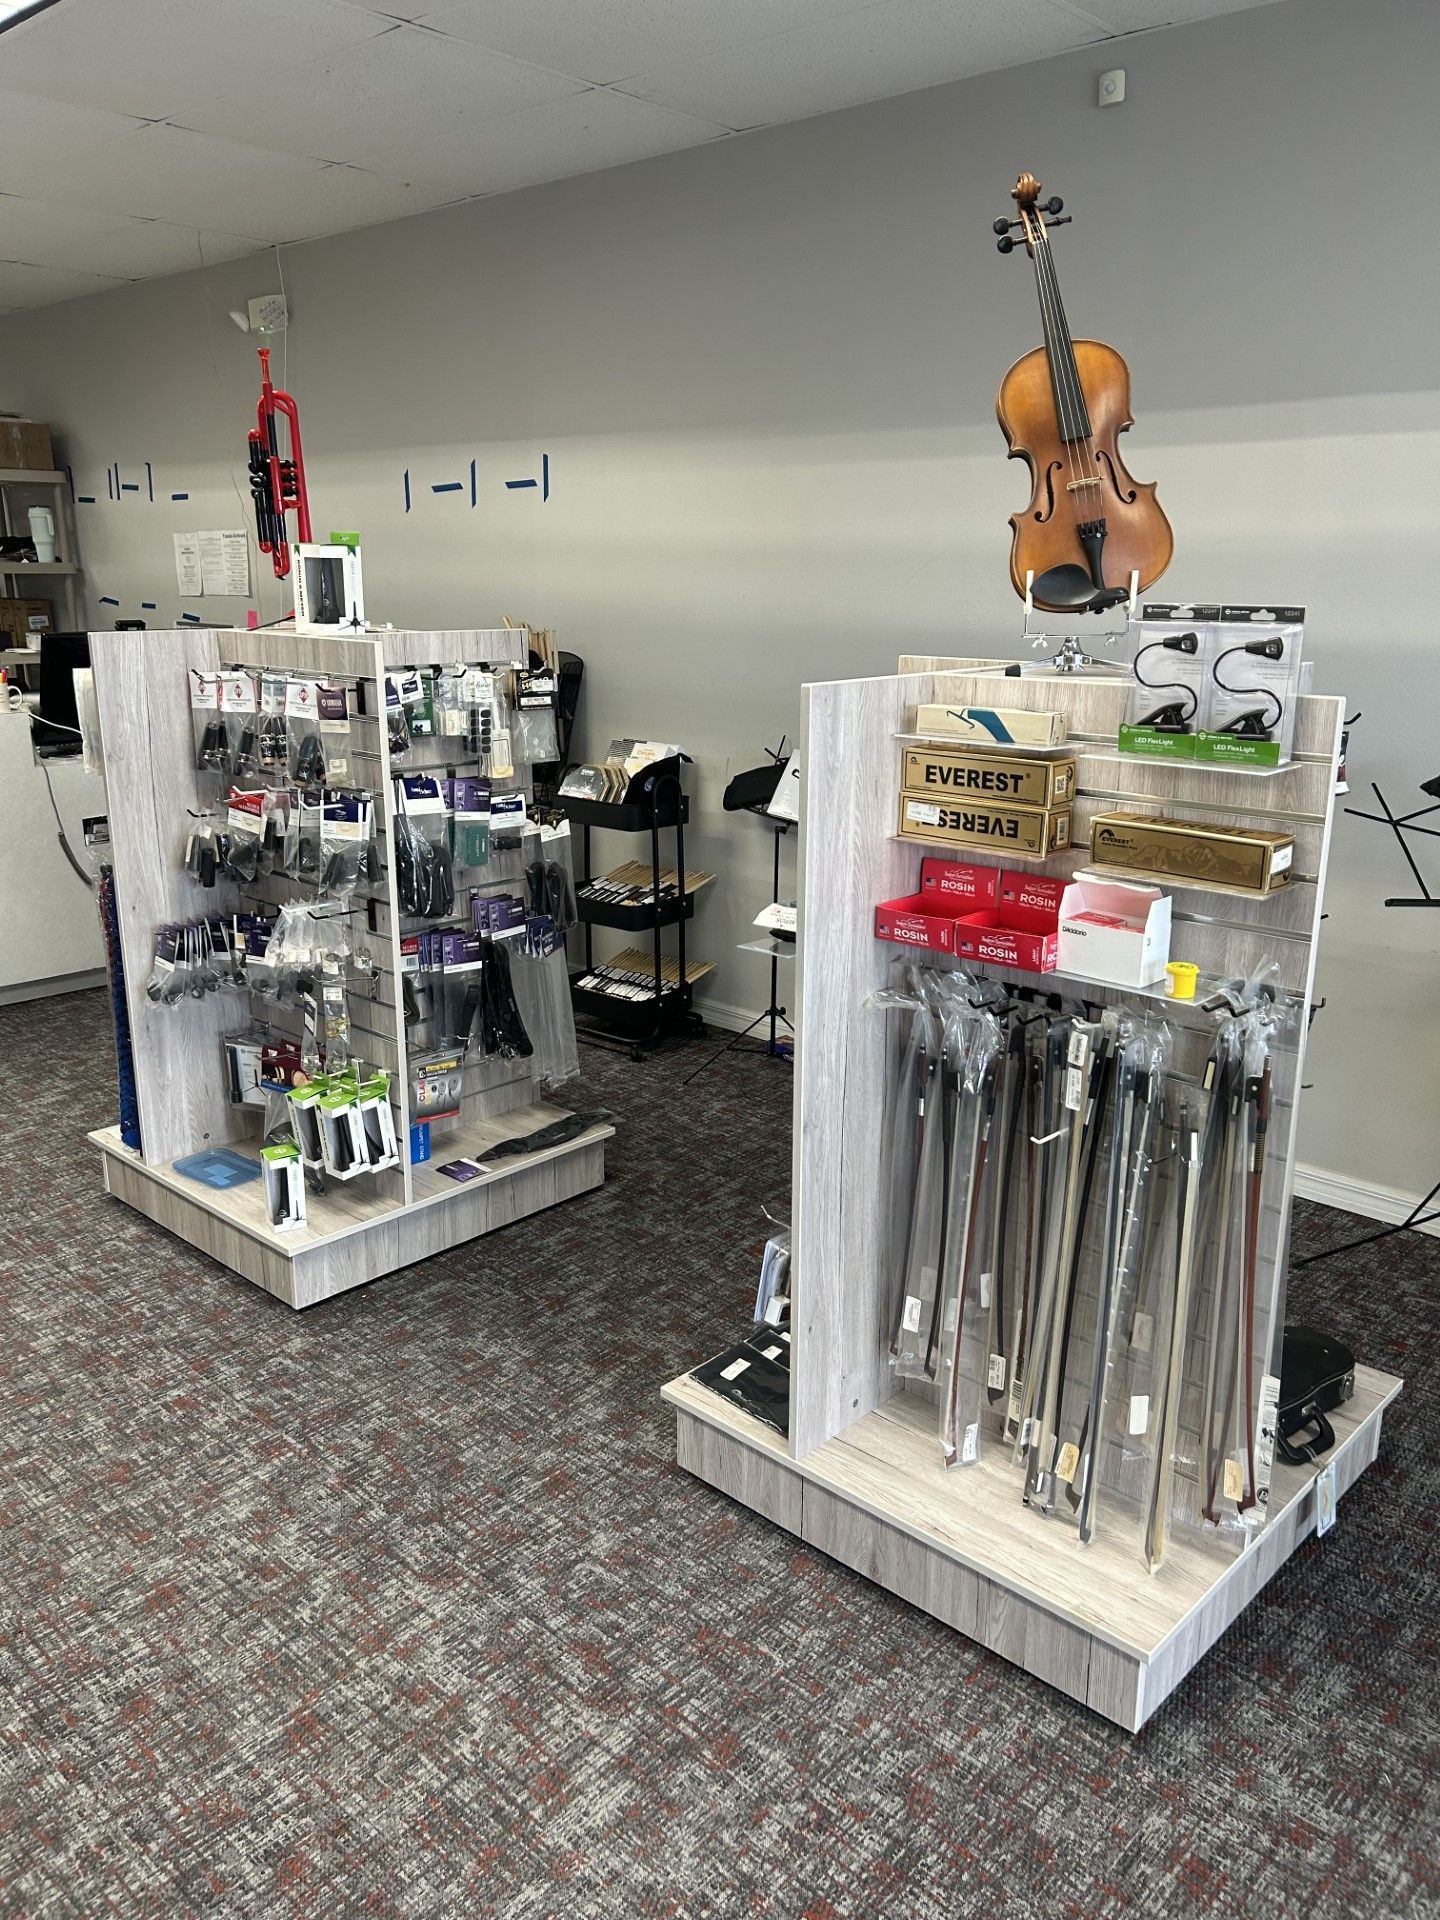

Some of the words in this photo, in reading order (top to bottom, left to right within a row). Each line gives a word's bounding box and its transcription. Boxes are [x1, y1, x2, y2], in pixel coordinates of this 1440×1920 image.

[925, 764, 1024, 794] EVEREST
[922, 809, 1019, 838] EVERES
[941, 879, 975, 892] ROSIN
[1020, 893, 1056, 908] ROSIN
[894, 928, 928, 942] ROSIN
[979, 945, 1017, 960] ROSIN
